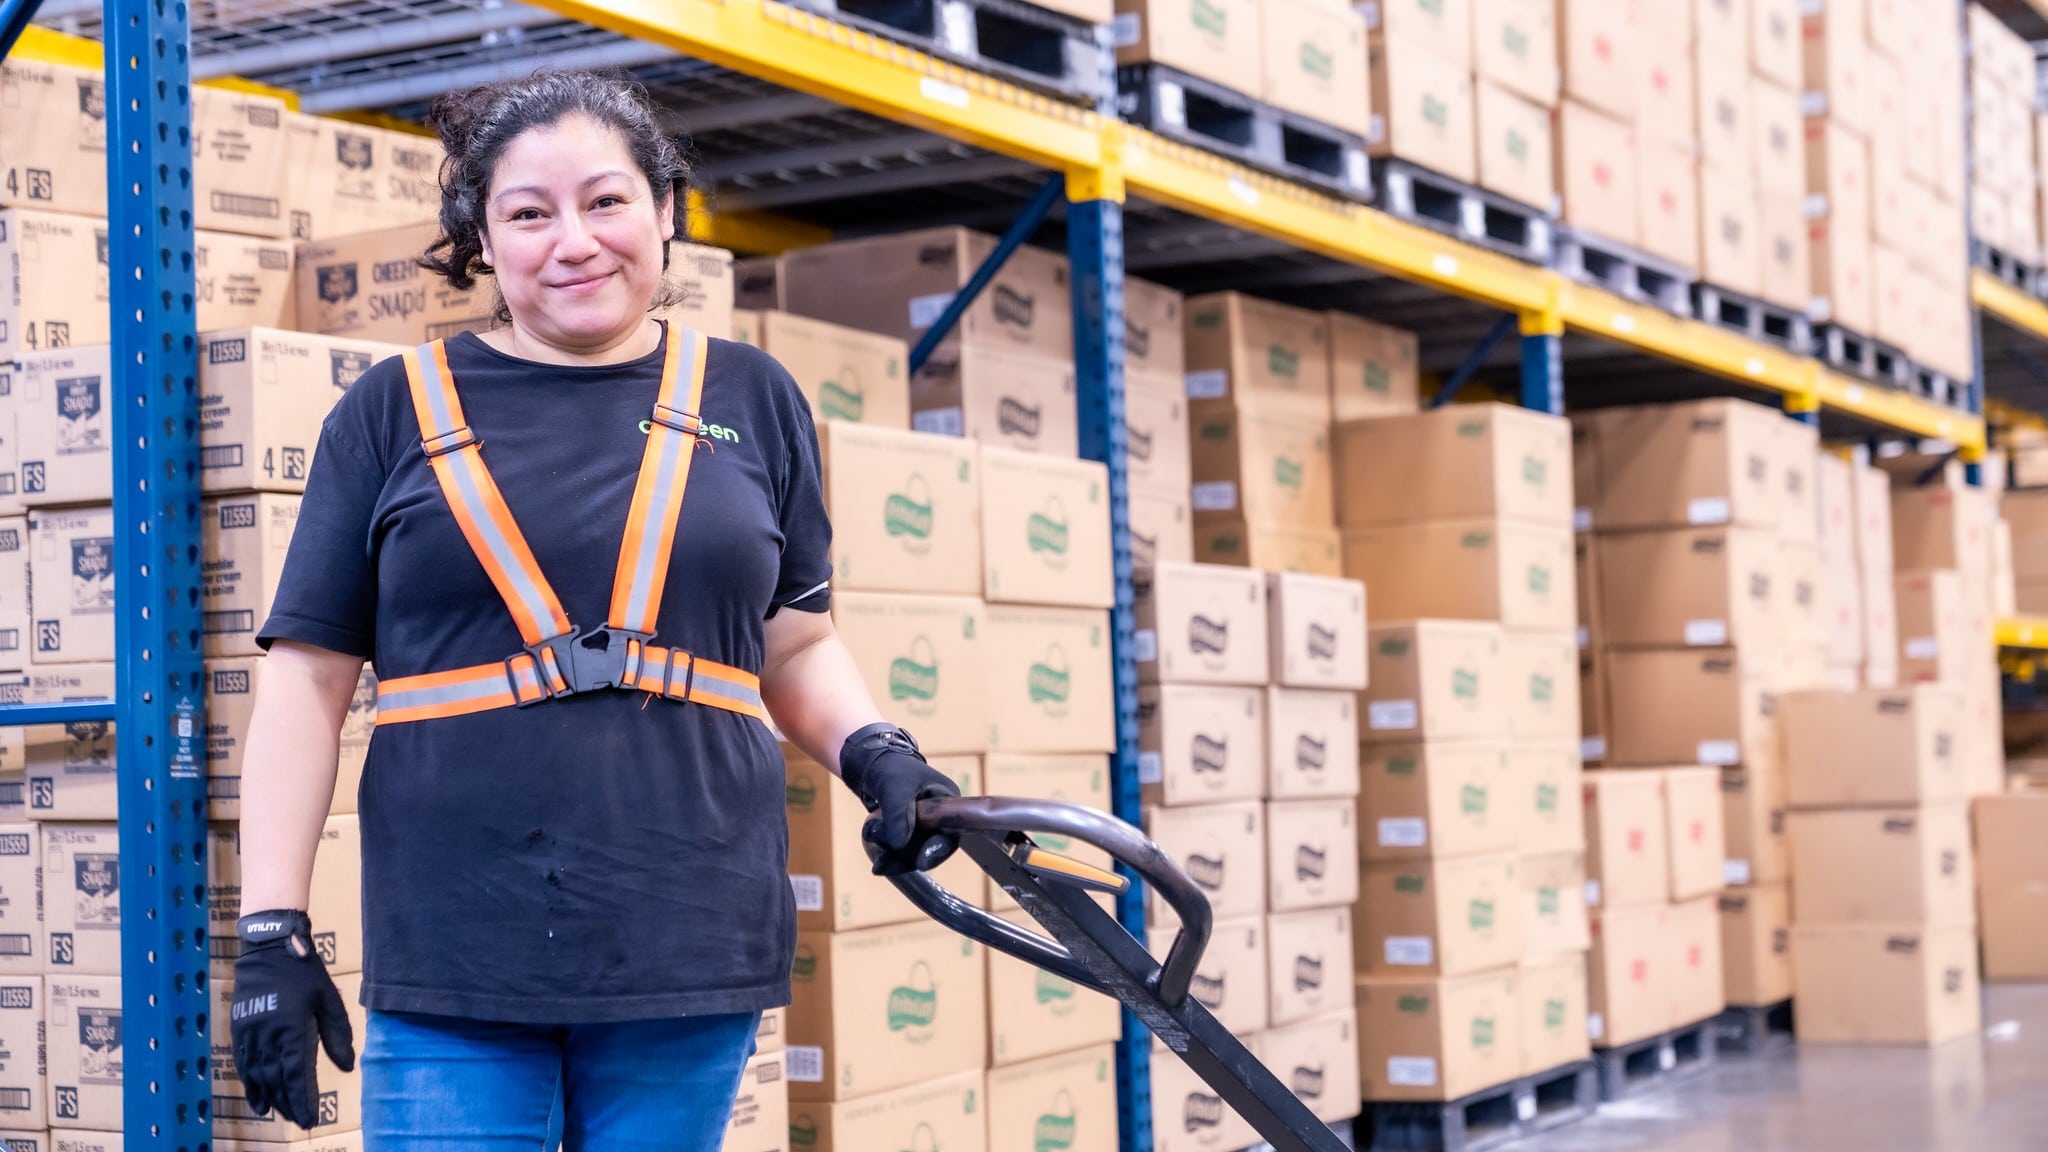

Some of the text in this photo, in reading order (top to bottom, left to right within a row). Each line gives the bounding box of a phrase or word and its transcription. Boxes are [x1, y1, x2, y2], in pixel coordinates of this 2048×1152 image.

[7, 168, 52, 200] 4 FS
[26, 321, 69, 350] 4 FS
[212, 341, 243, 363] 11559
[23, 463, 45, 492] FS
[263, 448, 304, 479] 4 FS
[222, 506, 252, 527] 11559
[0, 530, 18, 550] 559
[39, 621, 60, 650] FS
[216, 672, 247, 692] 11559
[31, 779, 53, 807] FS
[247, 922, 282, 933] UTILITY
[51, 933, 73, 963] FS
[314, 933, 335, 963] FS
[1, 988, 31, 1008] 11559
[232, 993, 278, 1021] ULINE
[56, 1087, 78, 1117] FS
[319, 1093, 337, 1124] FS
